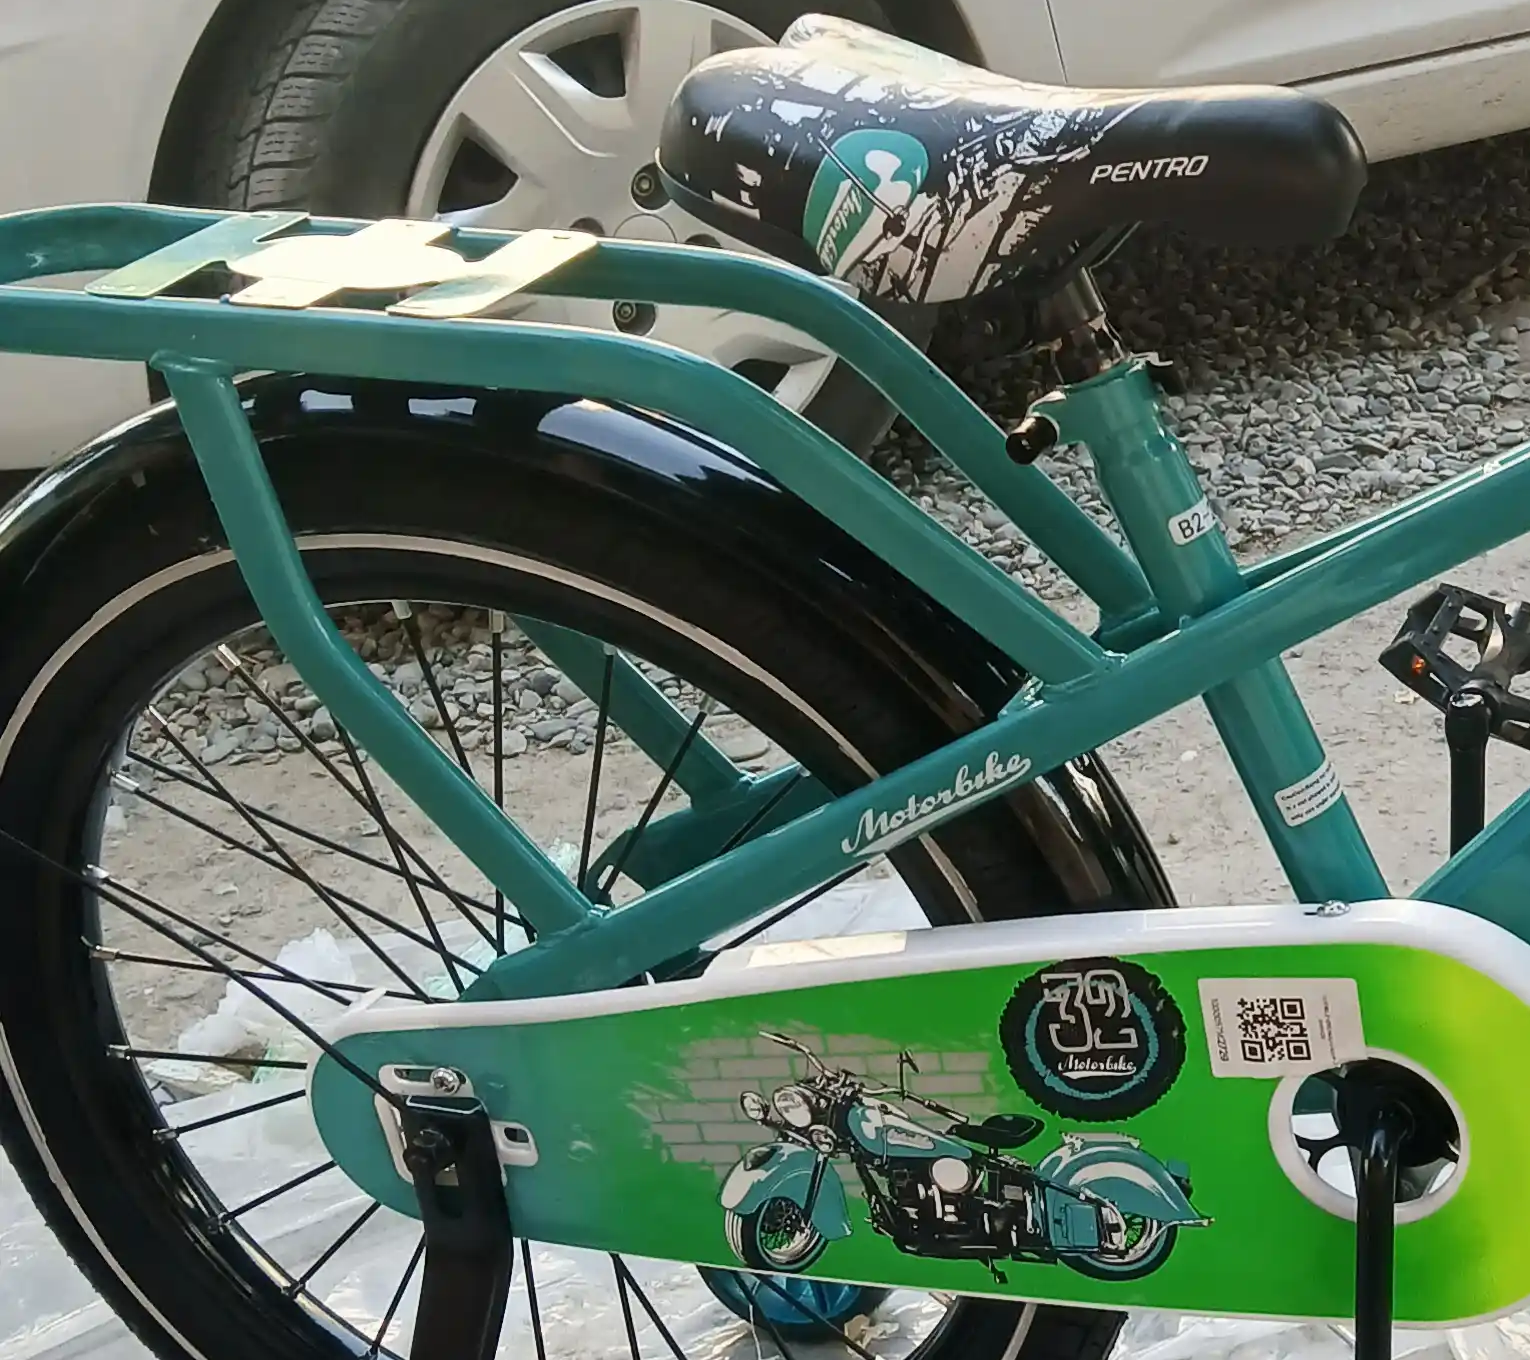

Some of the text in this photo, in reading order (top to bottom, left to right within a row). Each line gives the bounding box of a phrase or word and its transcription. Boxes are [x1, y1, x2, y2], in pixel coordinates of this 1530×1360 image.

[1089, 155, 1209, 184] PENTRO
[841, 751, 1031, 855] Motorbike
[1058, 1054, 1137, 1078] Motorbike
